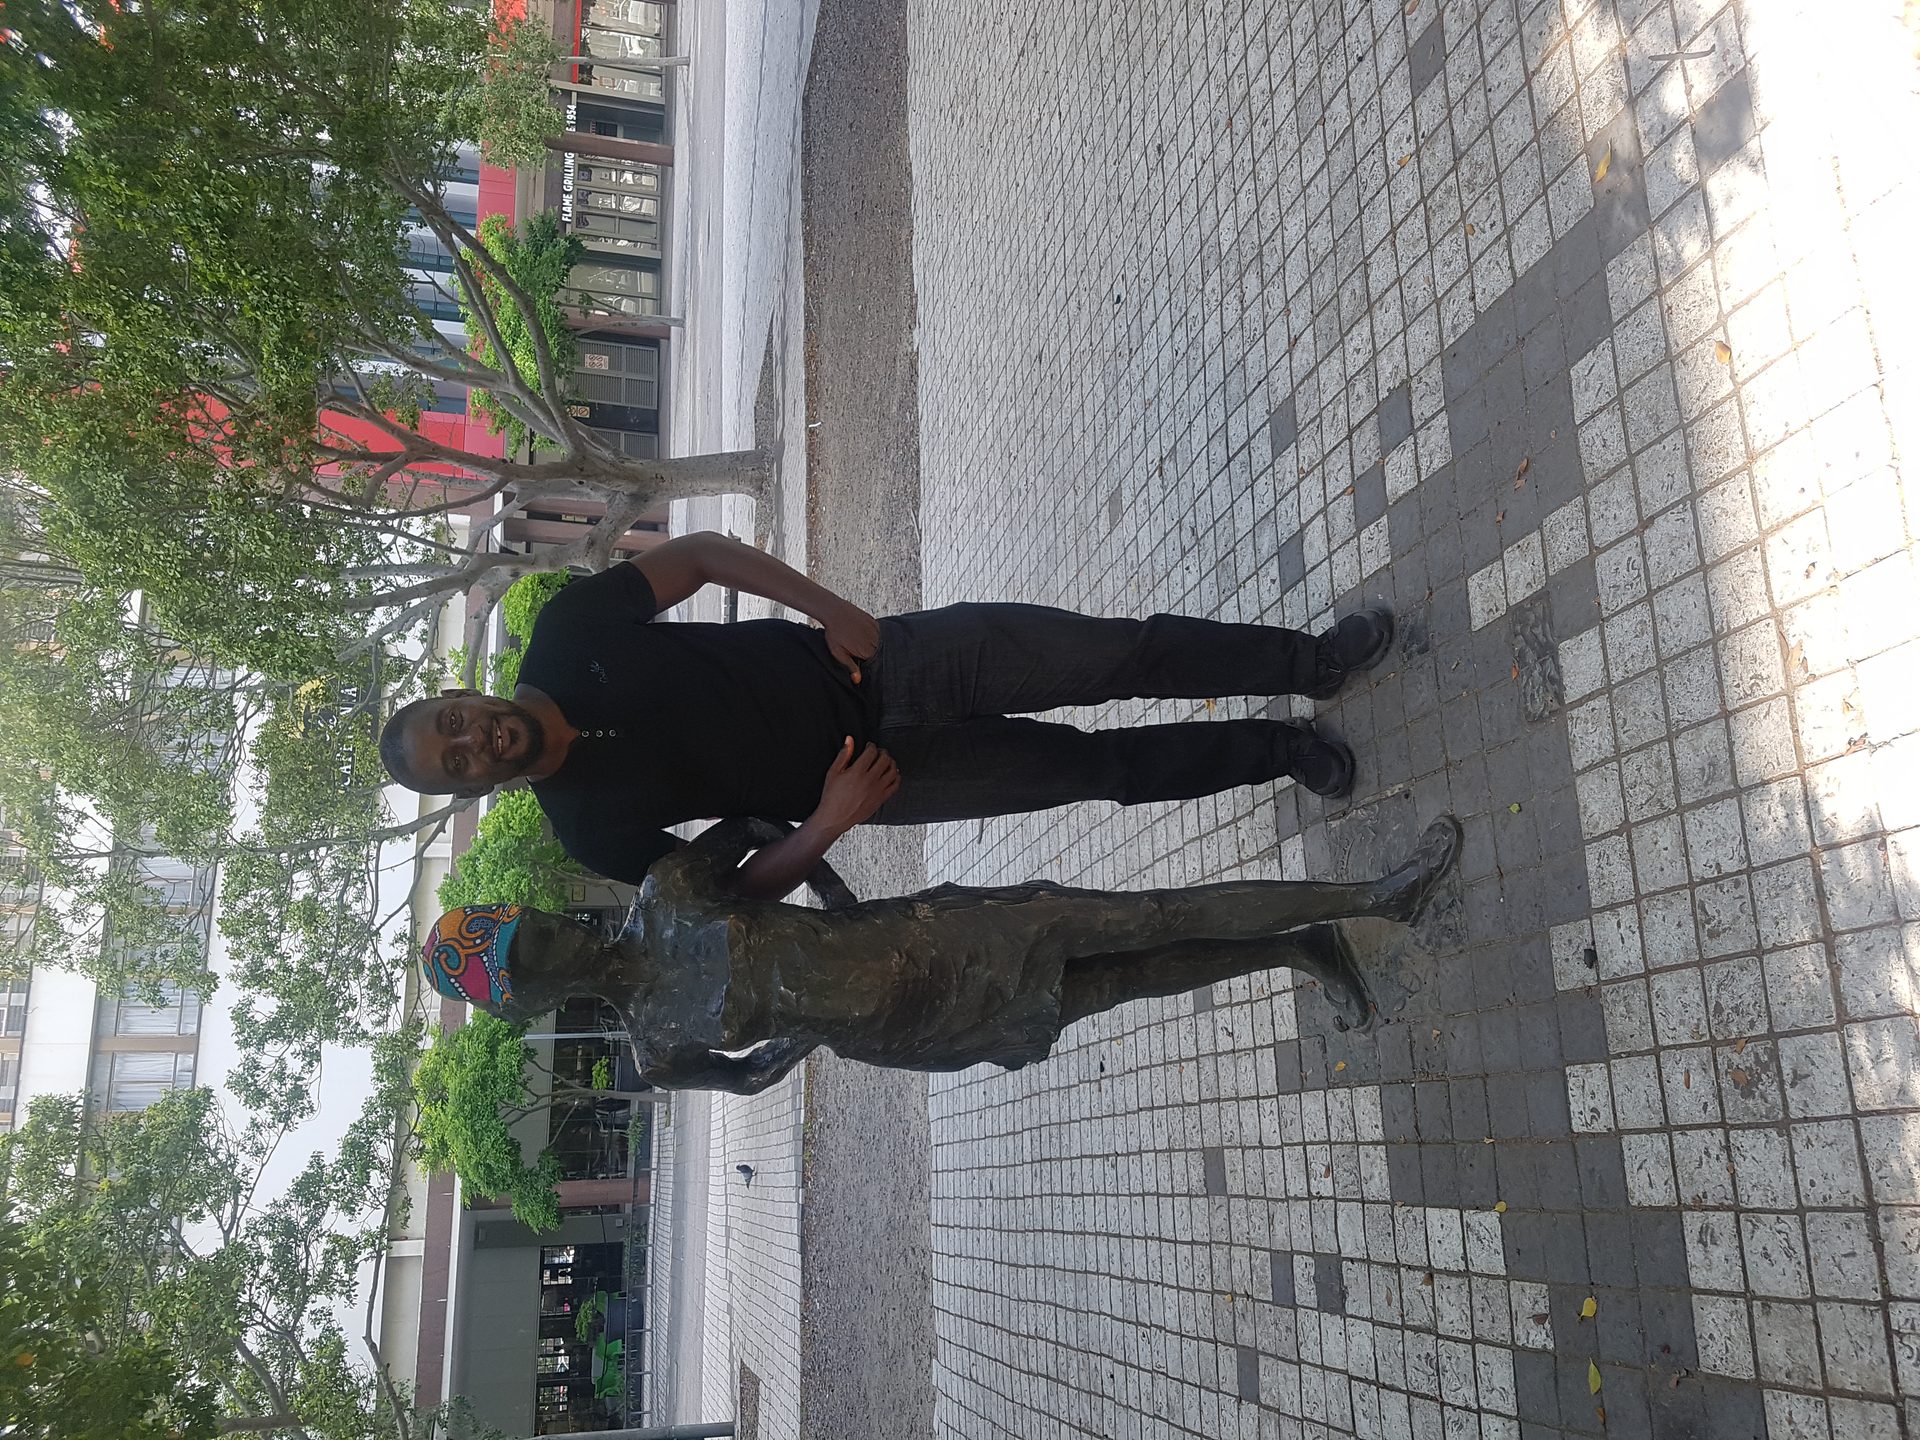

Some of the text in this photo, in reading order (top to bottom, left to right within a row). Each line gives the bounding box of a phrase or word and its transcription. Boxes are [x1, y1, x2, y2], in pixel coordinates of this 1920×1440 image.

[566, 104, 577, 125] 1954
[563, 152, 575, 192] GRILLING
[561, 194, 573, 222] FLAME
